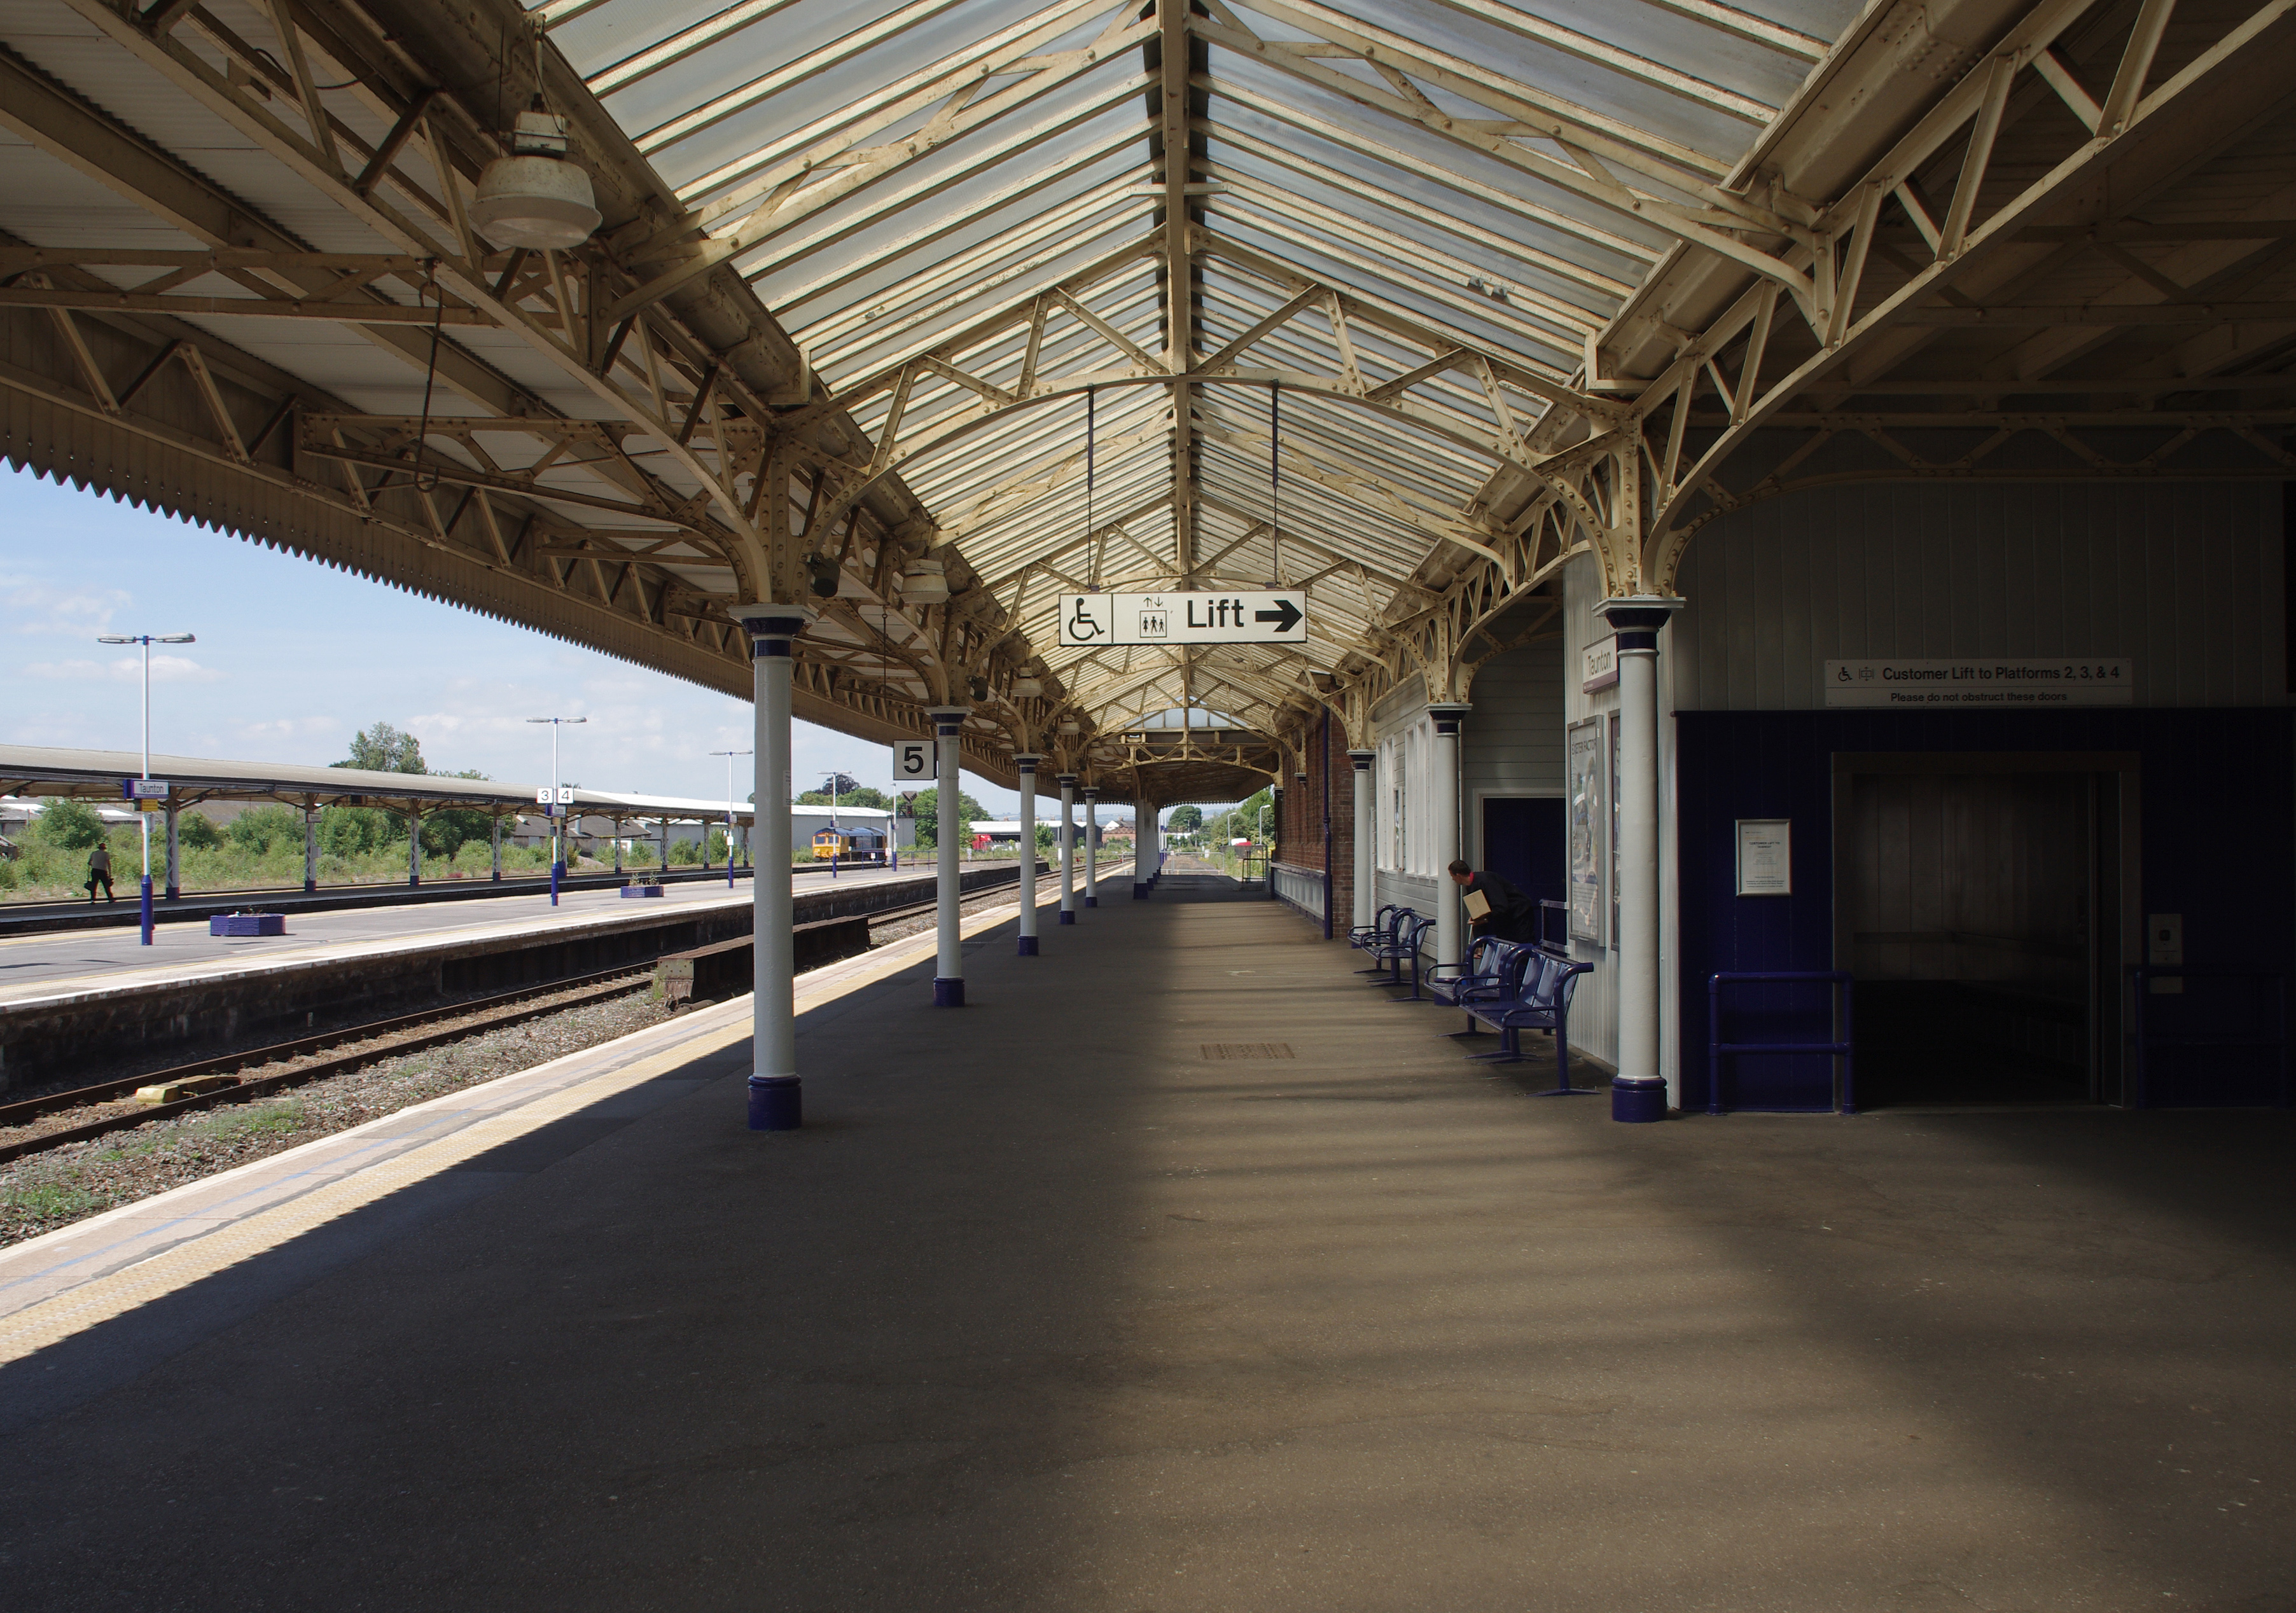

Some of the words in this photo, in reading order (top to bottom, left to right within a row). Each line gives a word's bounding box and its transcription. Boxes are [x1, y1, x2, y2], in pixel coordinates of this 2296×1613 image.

[1187, 599, 1244, 628] Lift
[1587, 649, 1611, 677] Taunton
[1882, 667, 1949, 681] Customer
[1952, 667, 1975, 680] Lift
[1979, 667, 1993, 680] to
[1995, 666, 2061, 679] Platforms
[2064, 666, 2077, 681] 2,
[2080, 666, 2093, 681] 3,
[2096, 665, 2107, 679] &
[2110, 665, 2120, 679] 4
[1891, 692, 1924, 702] Please
[1927, 692, 1940, 702] do
[1942, 692, 1959, 702] not
[1962, 692, 2005, 702] obstruct
[2007, 691, 2035, 702] these
[2037, 691, 2068, 701] doors
[903, 746, 924, 774] 5
[139, 783, 164, 793] Taunton
[541, 790, 549, 801] 3
[561, 790, 570, 801] 4
